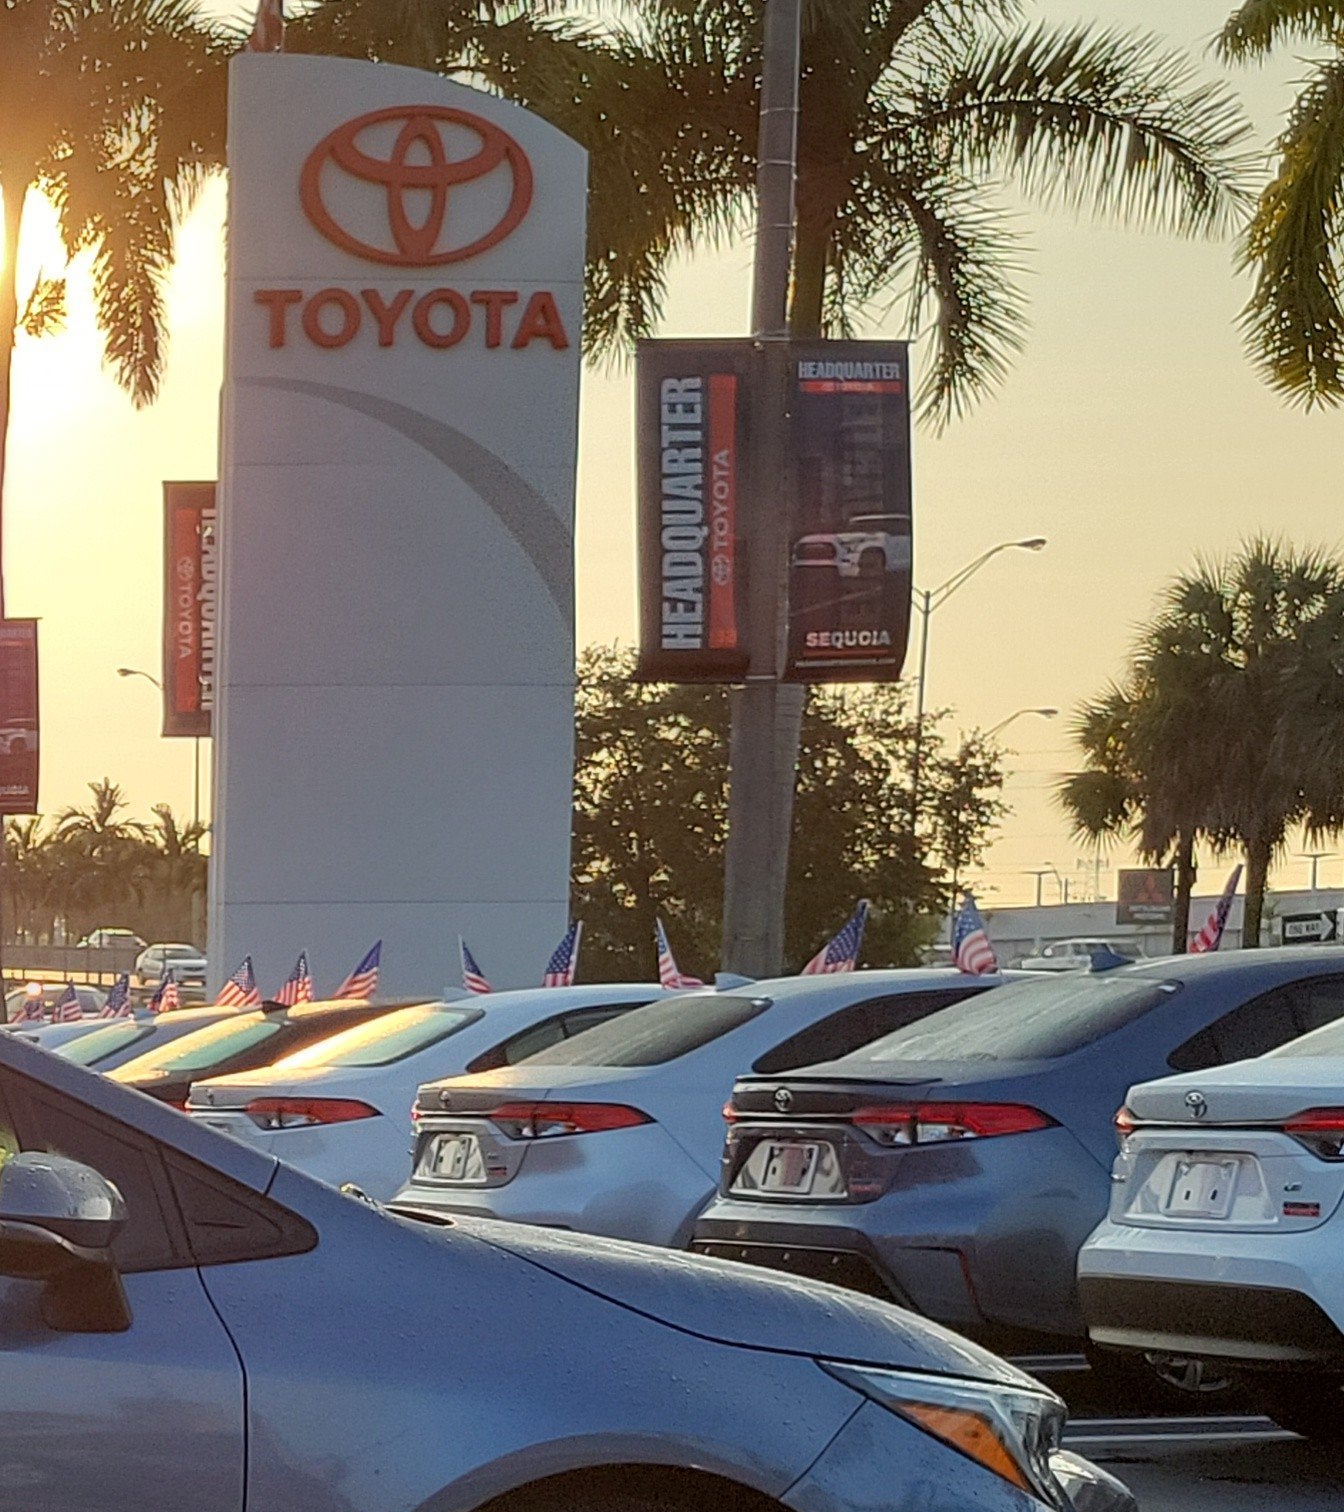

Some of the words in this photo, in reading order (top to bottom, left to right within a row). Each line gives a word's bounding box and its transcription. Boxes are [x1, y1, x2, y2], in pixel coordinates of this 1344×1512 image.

[253, 287, 569, 349] TOYOTA
[798, 361, 900, 382] HEADQUARTER
[661, 376, 709, 649] HEADQUARTER
[713, 449, 731, 551] TOYOTA
[177, 584, 193, 659] TOYOTA
[806, 630, 891, 649] SEQUOIA
